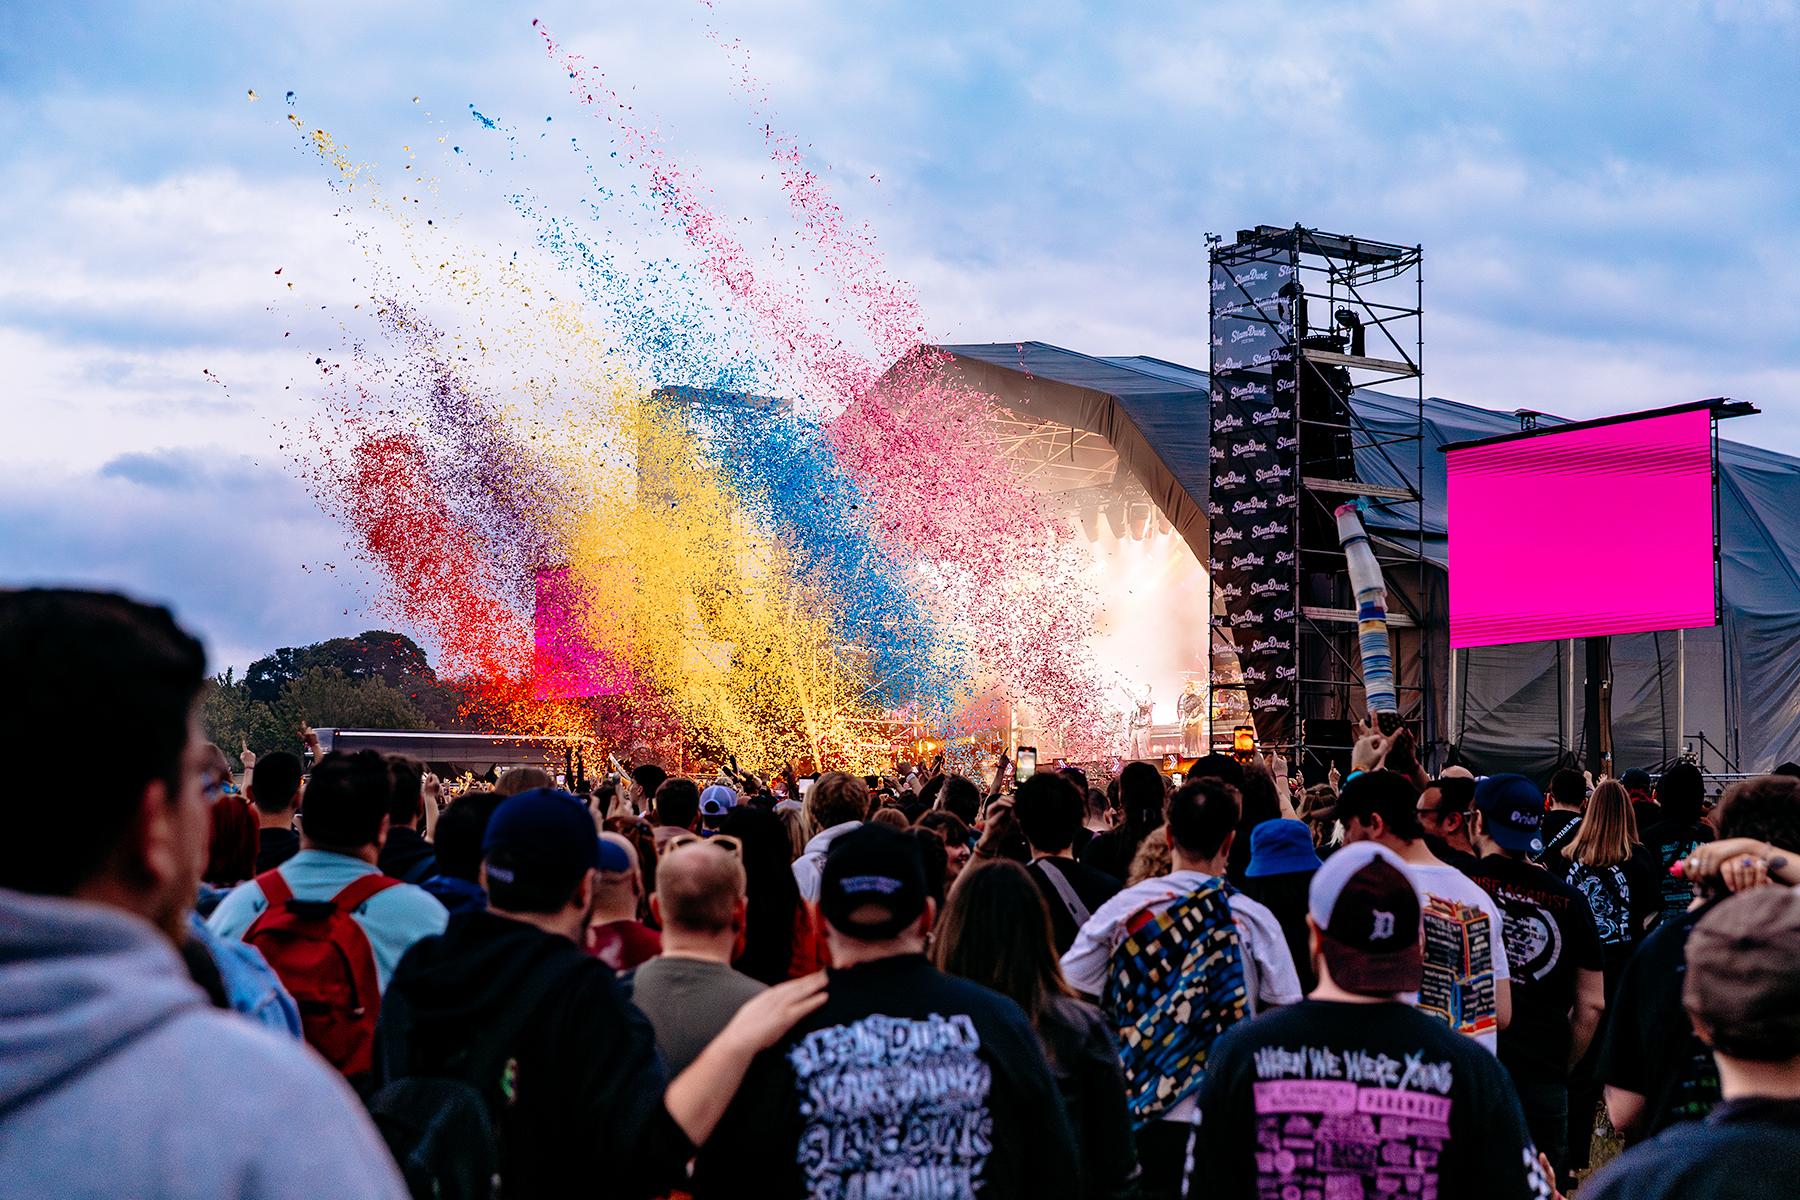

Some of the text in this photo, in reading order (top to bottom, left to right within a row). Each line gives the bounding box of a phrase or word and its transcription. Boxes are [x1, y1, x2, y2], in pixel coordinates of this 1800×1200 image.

[1369, 908, 1395, 941] D
[1254, 1045, 1307, 1079] WHEN
[1309, 1046, 1342, 1079] WE
